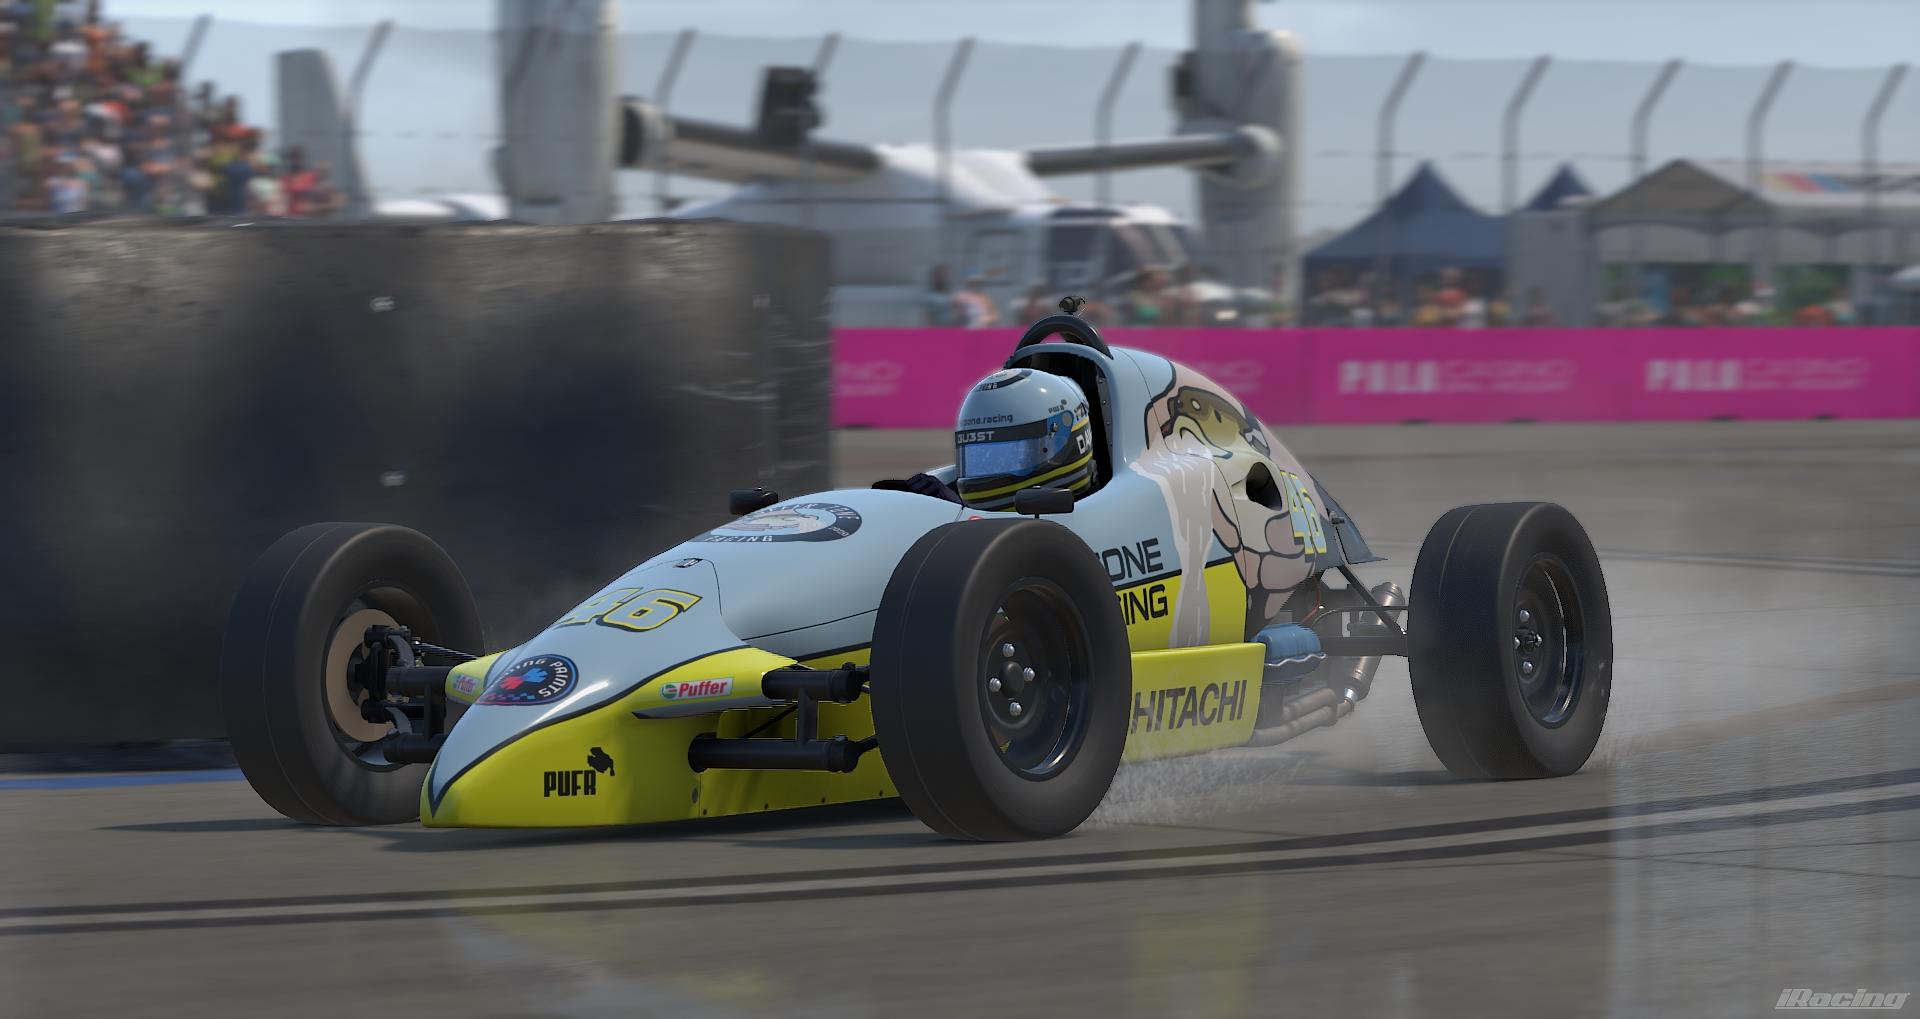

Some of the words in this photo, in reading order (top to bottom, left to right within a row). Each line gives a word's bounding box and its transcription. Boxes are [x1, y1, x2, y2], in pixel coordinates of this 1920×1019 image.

[1096, 537, 1164, 581] ONE
[553, 586, 703, 633] 46
[1118, 584, 1169, 626] ING
[678, 680, 727, 698] Puffer
[1130, 679, 1248, 734] HITACHI
[543, 769, 597, 798] PUFR
